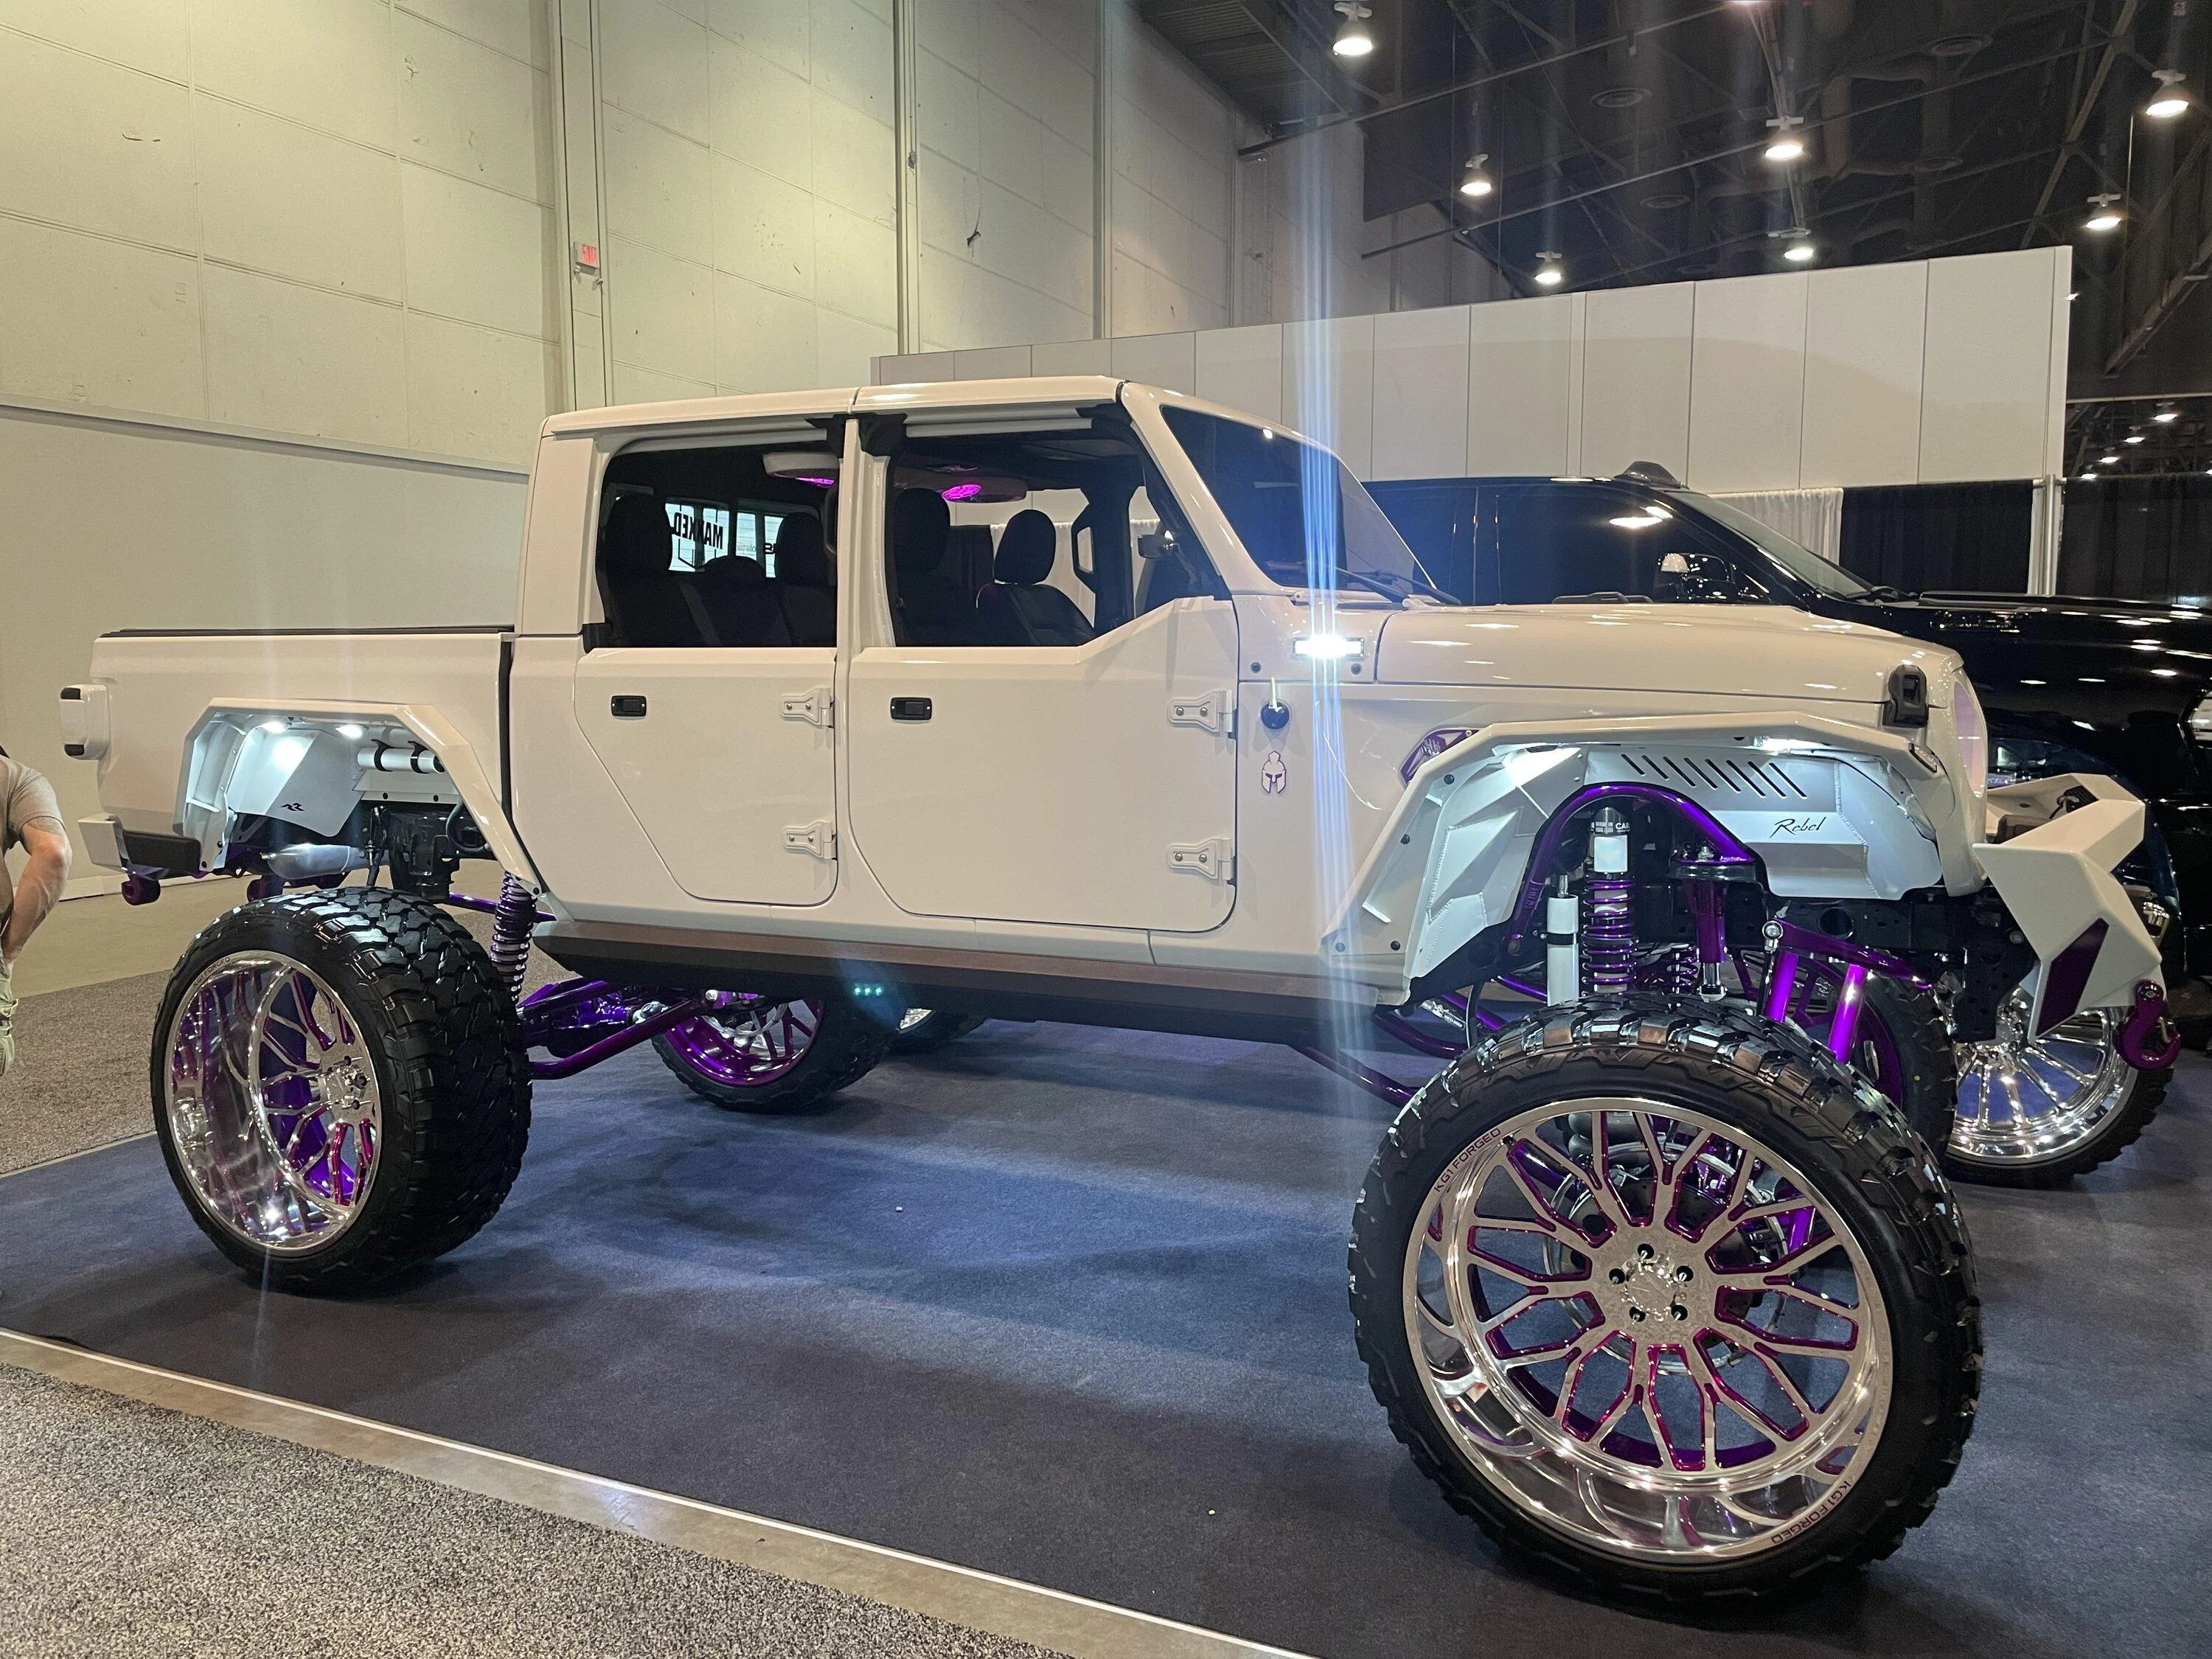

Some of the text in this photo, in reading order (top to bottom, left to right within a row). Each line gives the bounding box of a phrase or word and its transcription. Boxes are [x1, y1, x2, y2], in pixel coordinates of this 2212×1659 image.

[1770, 816, 1826, 838] Rebel
[204, 957, 230, 975] FORGED
[1434, 1128, 1501, 1192] KG1 FORGED
[1771, 1481, 1852, 1544] KG1 FORGED
